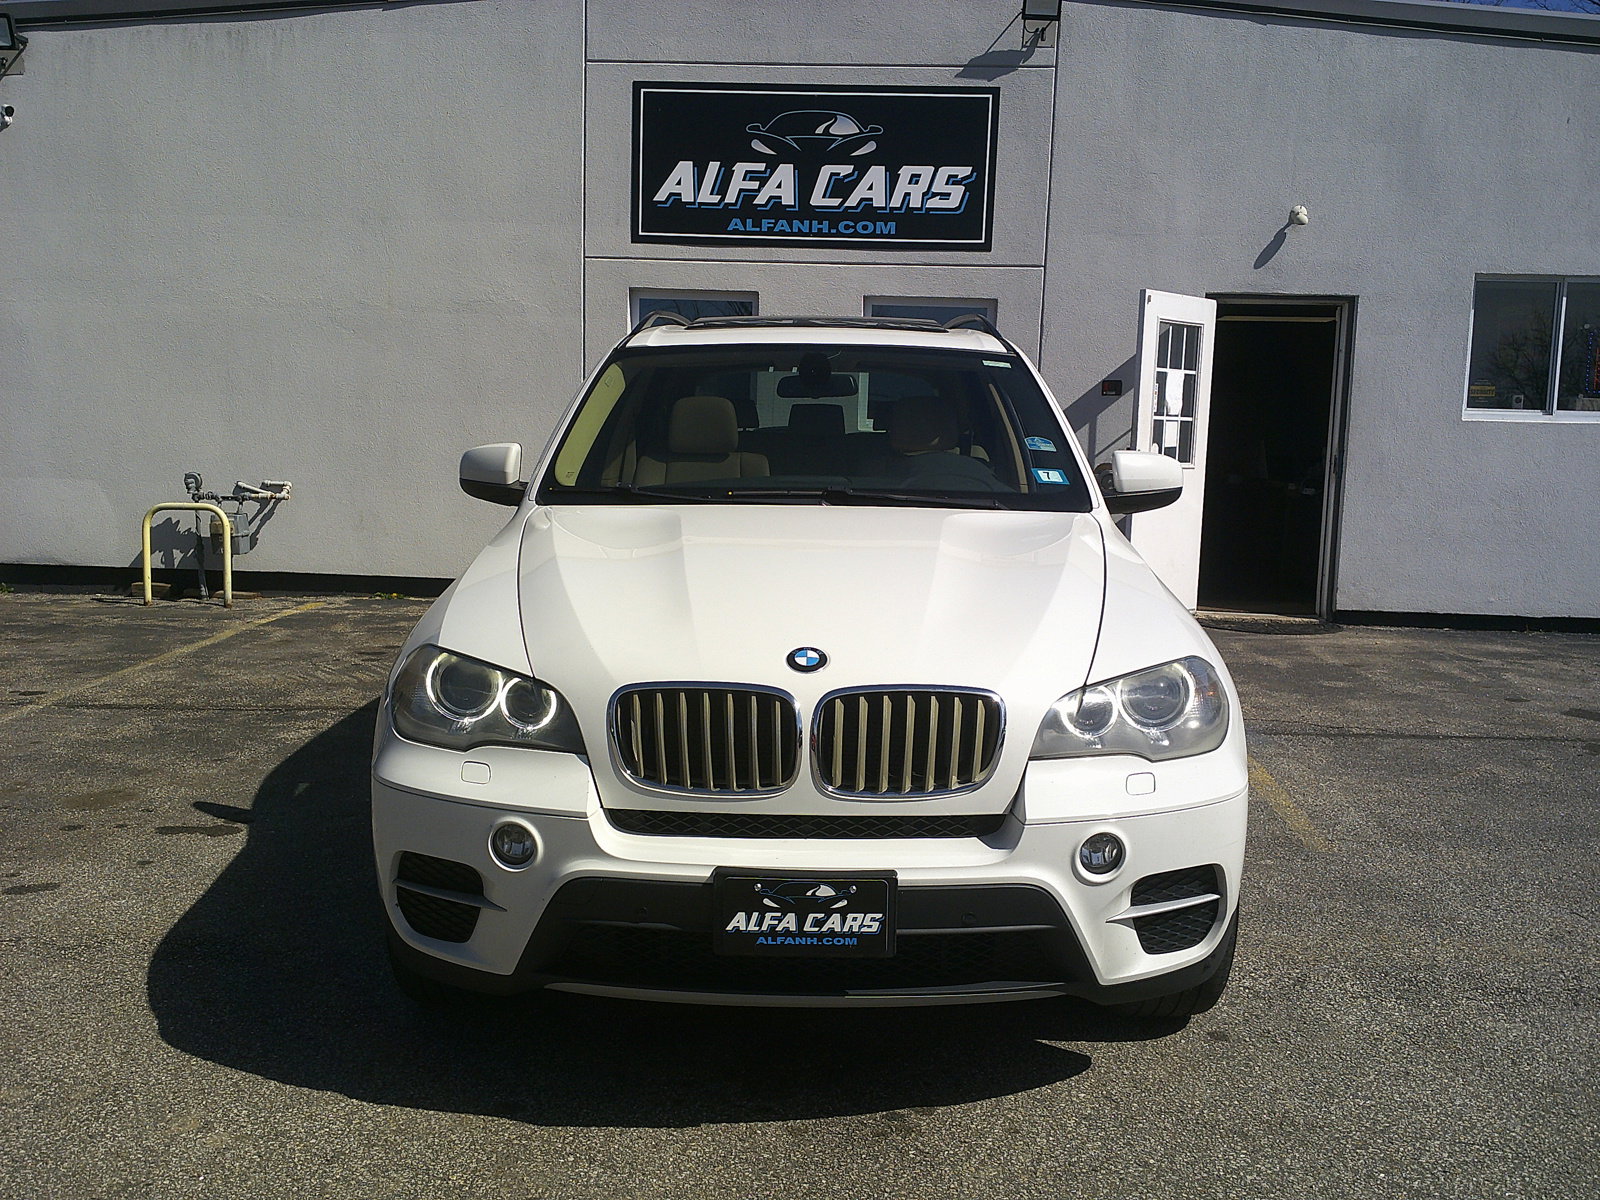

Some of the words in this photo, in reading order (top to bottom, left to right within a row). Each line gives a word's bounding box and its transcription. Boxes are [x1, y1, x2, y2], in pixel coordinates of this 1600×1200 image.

[653, 160, 798, 211] ALFA
[809, 164, 977, 213] CARS
[727, 217, 897, 235] ALFANH.COM
[1042, 471, 1051, 480] 7
[725, 911, 799, 933] ALFA
[803, 913, 886, 935] CARS
[756, 936, 858, 946] ALFANH.COM
